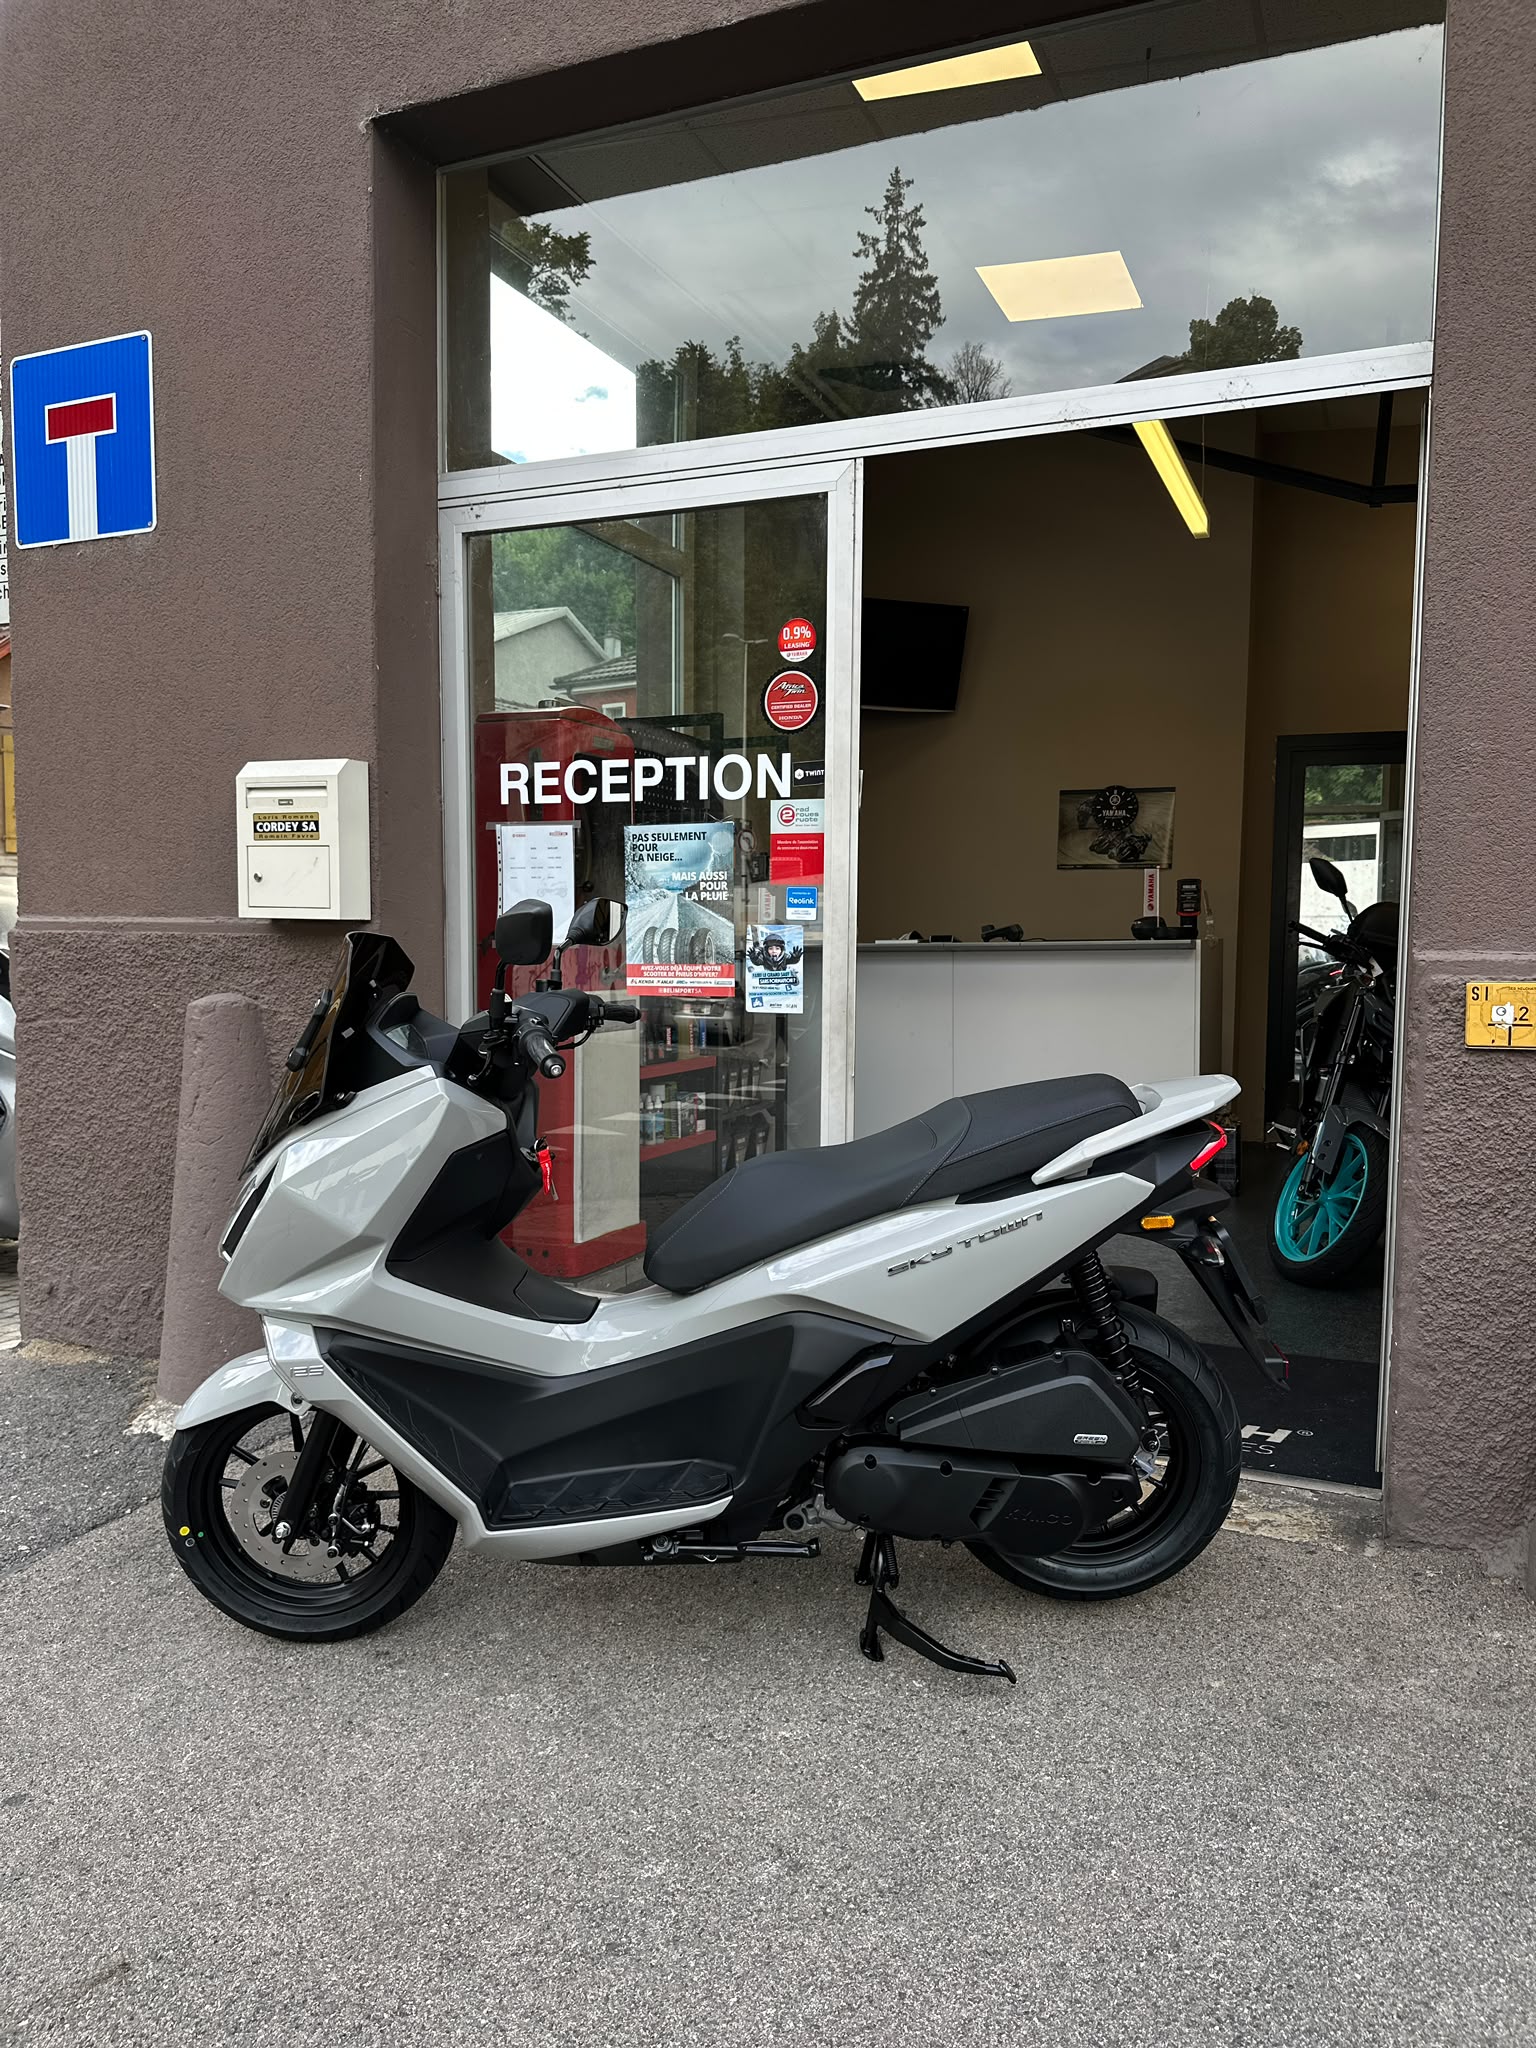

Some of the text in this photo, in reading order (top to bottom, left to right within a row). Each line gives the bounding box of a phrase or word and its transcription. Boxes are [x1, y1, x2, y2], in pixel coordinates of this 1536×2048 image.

[783, 626, 811, 640] 0.9%
[499, 752, 791, 805] RECEPTION
[781, 809, 793, 820] 2
[256, 821, 317, 832] CORDEY SA
[632, 832, 707, 842] PAS SEULEMENT
[632, 843, 658, 852] POUR
[632, 852, 683, 862] LA NEIGE...
[672, 870, 728, 880] MAIS AUSSI
[700, 881, 728, 891] POUR
[1147, 873, 1155, 903] YAMAHA
[685, 891, 728, 901] LA PLUIE
[788, 897, 815, 905] Reolink
[956, 1210, 1043, 1248] TOWN
[290, 1364, 324, 1378] 125
